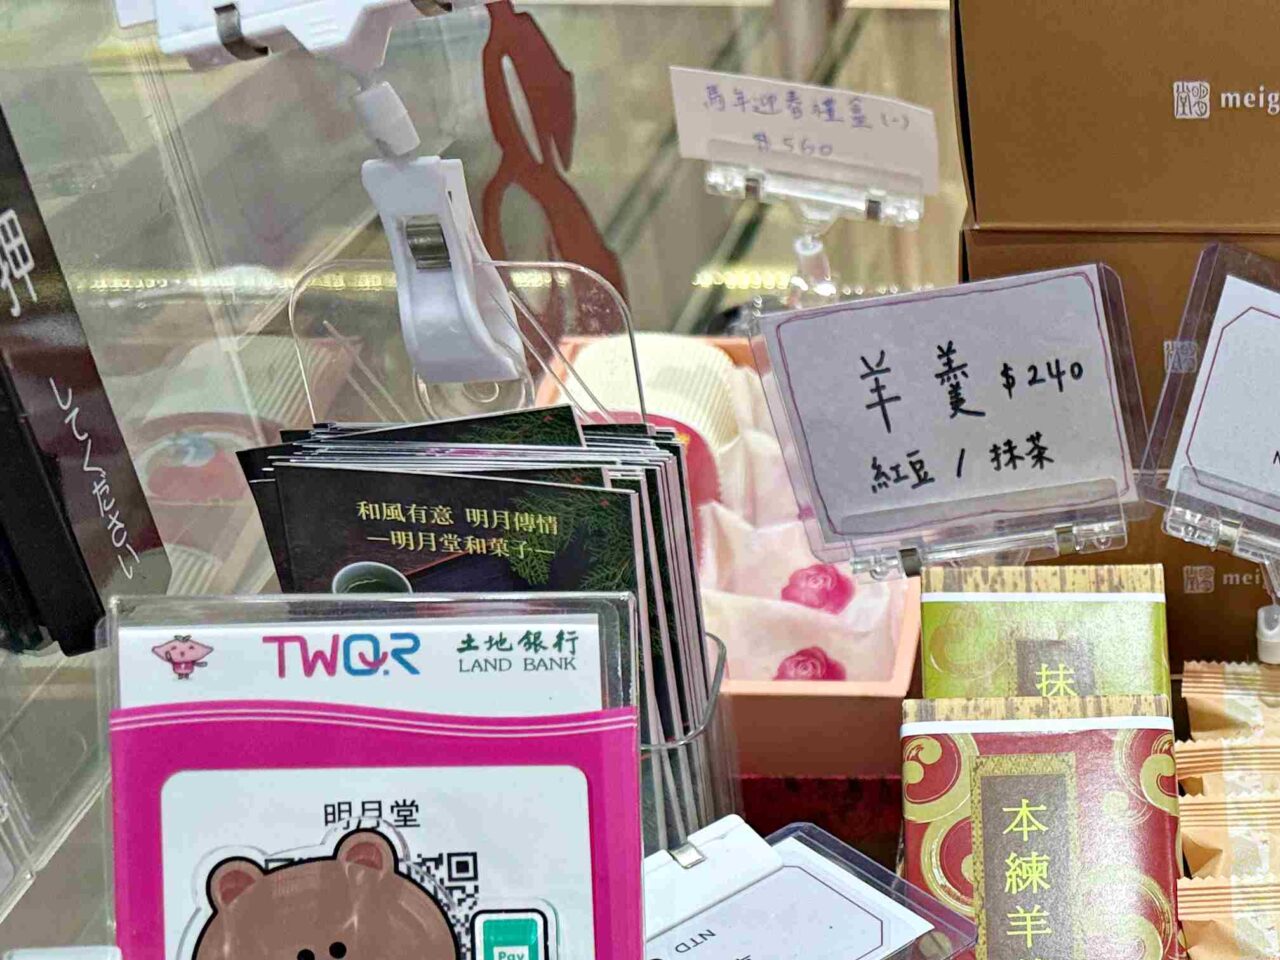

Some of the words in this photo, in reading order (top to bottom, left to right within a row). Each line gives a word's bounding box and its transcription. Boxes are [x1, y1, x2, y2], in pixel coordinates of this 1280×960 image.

[860, 340, 986, 433] 羊羹
[1001, 358, 1083, 400] $240
[871, 449, 935, 493] 紅豆
[989, 431, 1054, 471] 抹茶
[49, 377, 140, 580] してください
[356, 501, 454, 526] 和風有意
[456, 630, 579, 656] 土地銀行
[458, 657, 512, 673] LAND
[523, 657, 577, 673] BANK
[323, 798, 421, 831] 明月堂
[674, 929, 717, 954] NTD
